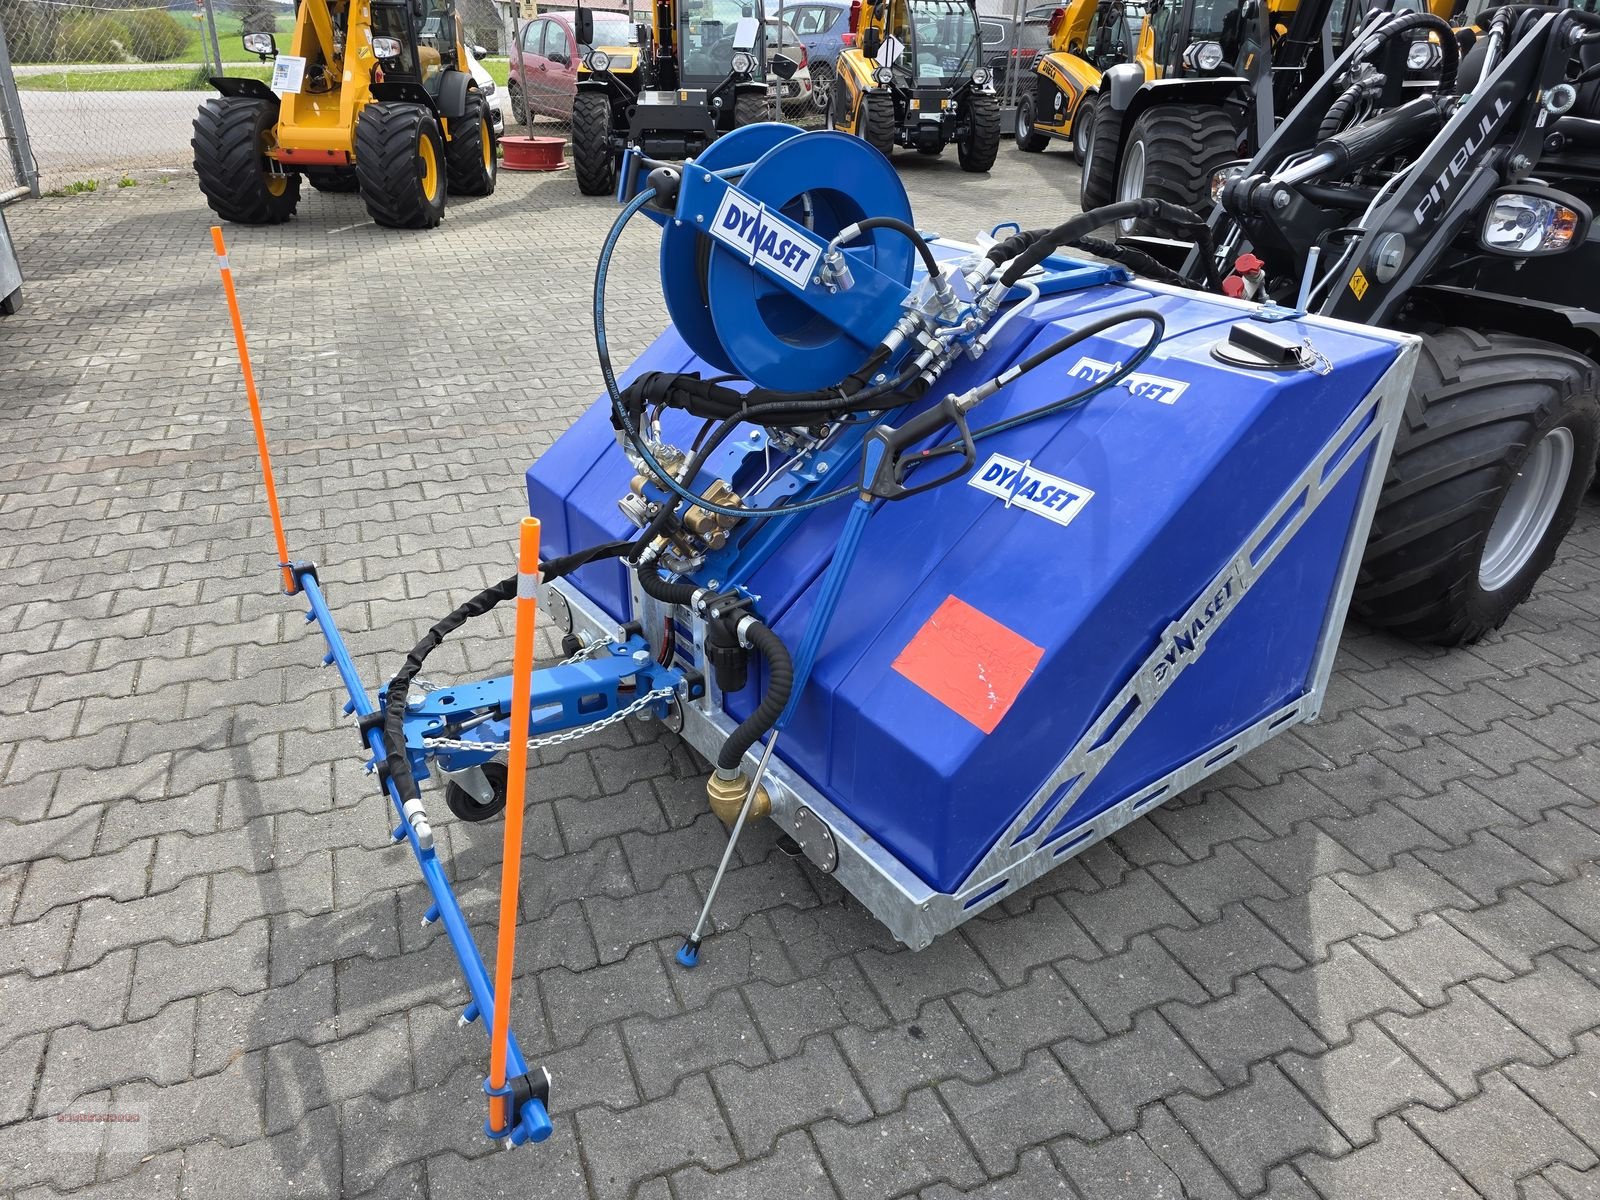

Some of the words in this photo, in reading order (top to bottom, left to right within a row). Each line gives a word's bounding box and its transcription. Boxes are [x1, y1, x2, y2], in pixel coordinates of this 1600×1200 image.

[1413, 98, 1511, 225] PITBULL
[722, 204, 811, 272] DYNASET
[981, 462, 1080, 511] DYNASET
[1153, 576, 1233, 682] DYNASET
